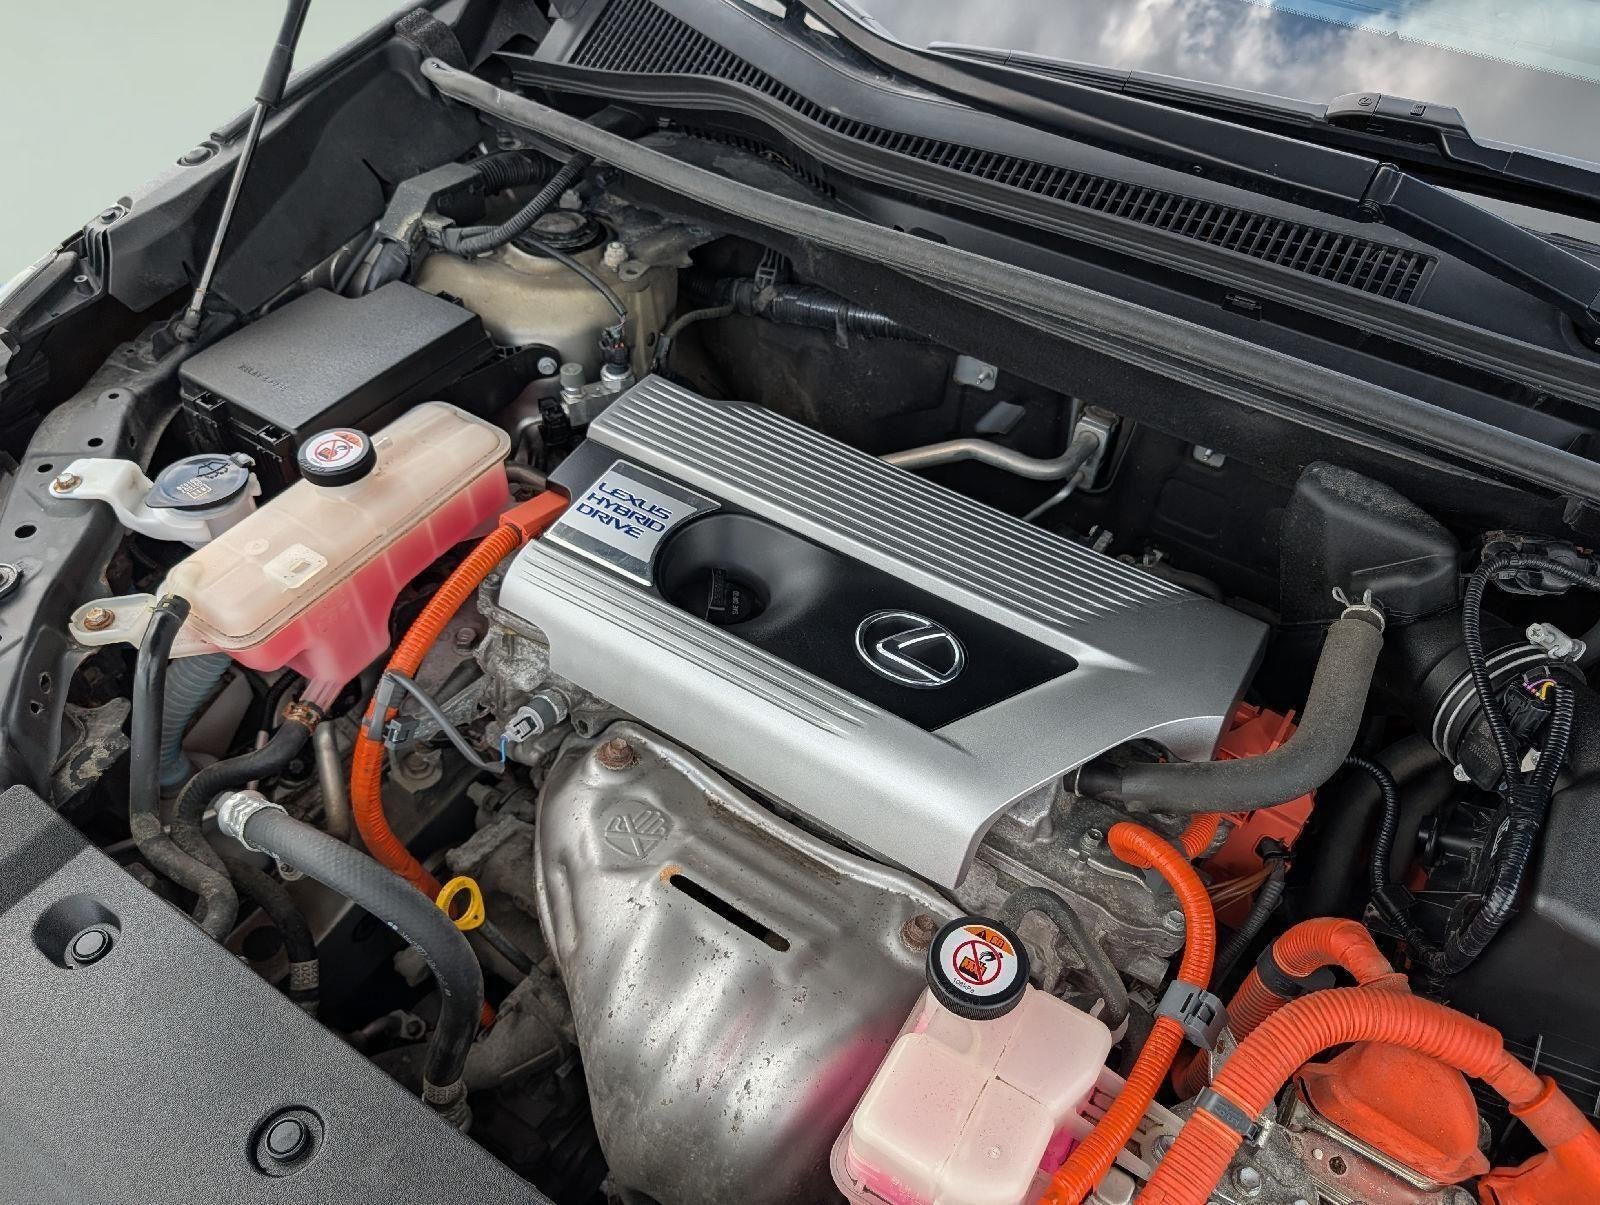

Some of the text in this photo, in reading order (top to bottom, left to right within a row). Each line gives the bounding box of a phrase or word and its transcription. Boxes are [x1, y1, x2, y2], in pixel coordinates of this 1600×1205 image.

[587, 492, 666, 533] HYBRID
[599, 482, 672, 519] LEXUS
[576, 503, 644, 539] DRIVE
